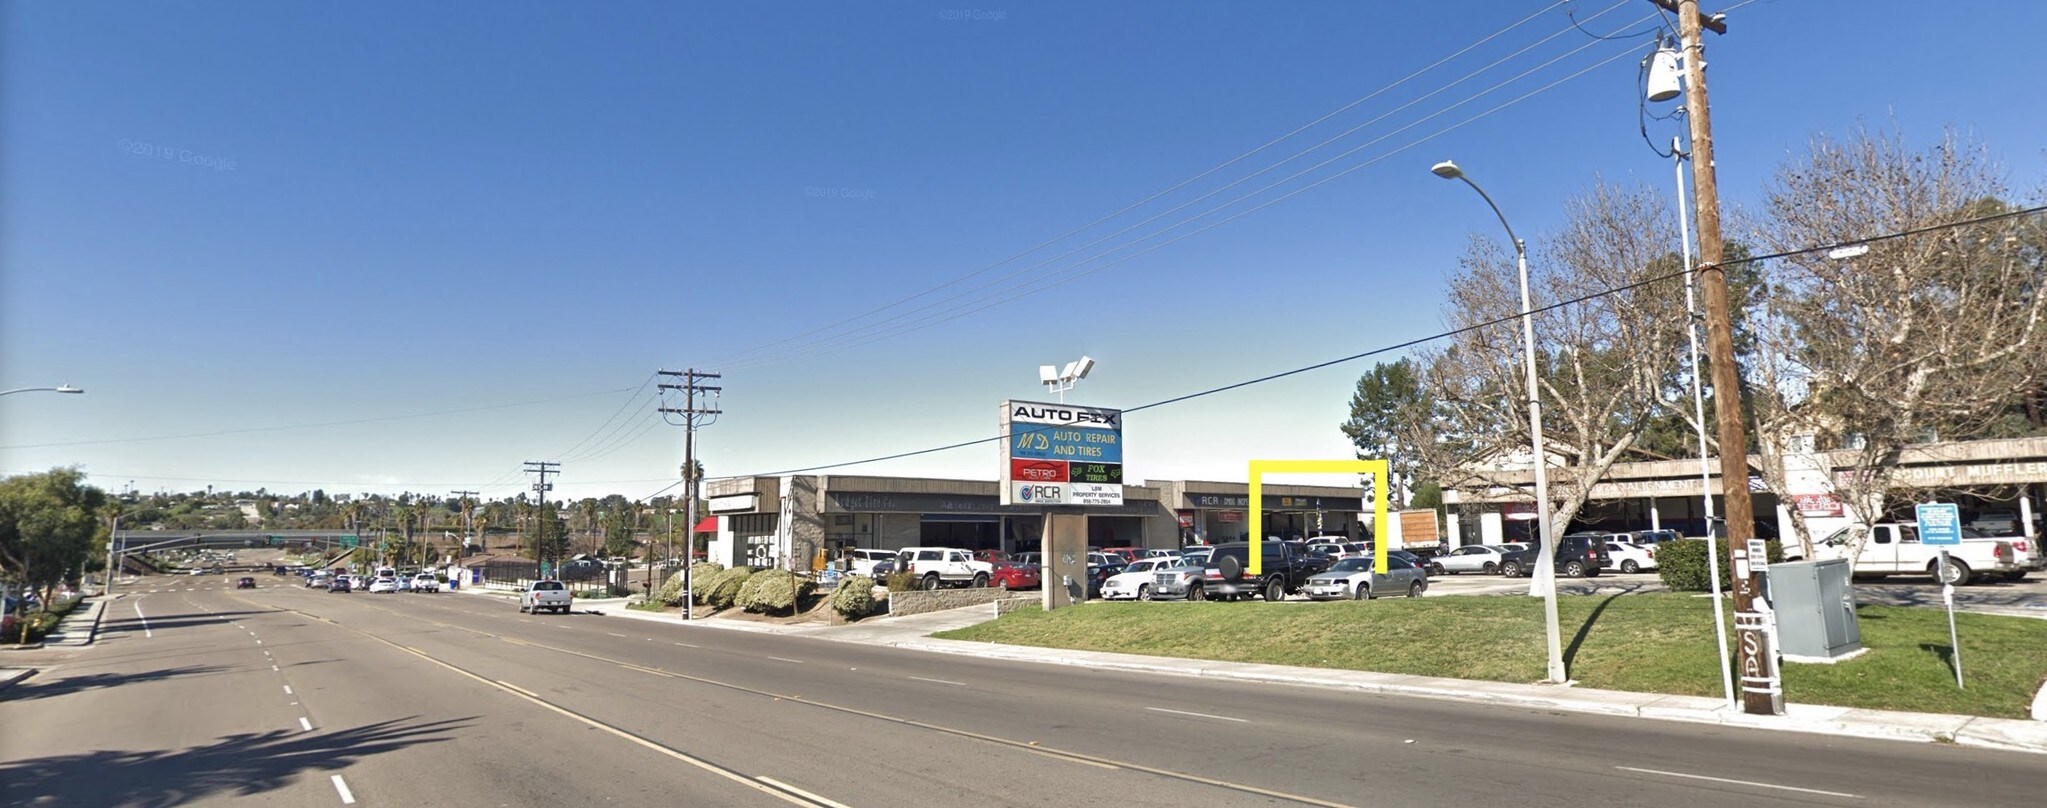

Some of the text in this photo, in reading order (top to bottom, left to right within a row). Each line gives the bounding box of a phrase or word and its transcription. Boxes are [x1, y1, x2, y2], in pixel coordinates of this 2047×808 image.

[1014, 406, 1116, 424] AUTO FIX
[1053, 431, 1116, 444] AUTO REPAIR
[1053, 445, 1102, 457] AND TIRES
[1023, 468, 1056, 478] PETRO
[1087, 465, 1106, 473] FOX
[1892, 463, 2047, 481] SCOUNT MUFFLER
[1086, 474, 1108, 482] TIRES
[1628, 480, 1696, 490] ALIGNMENT
[1034, 486, 1061, 499] RCR
[1202, 496, 1218, 505] RCR
